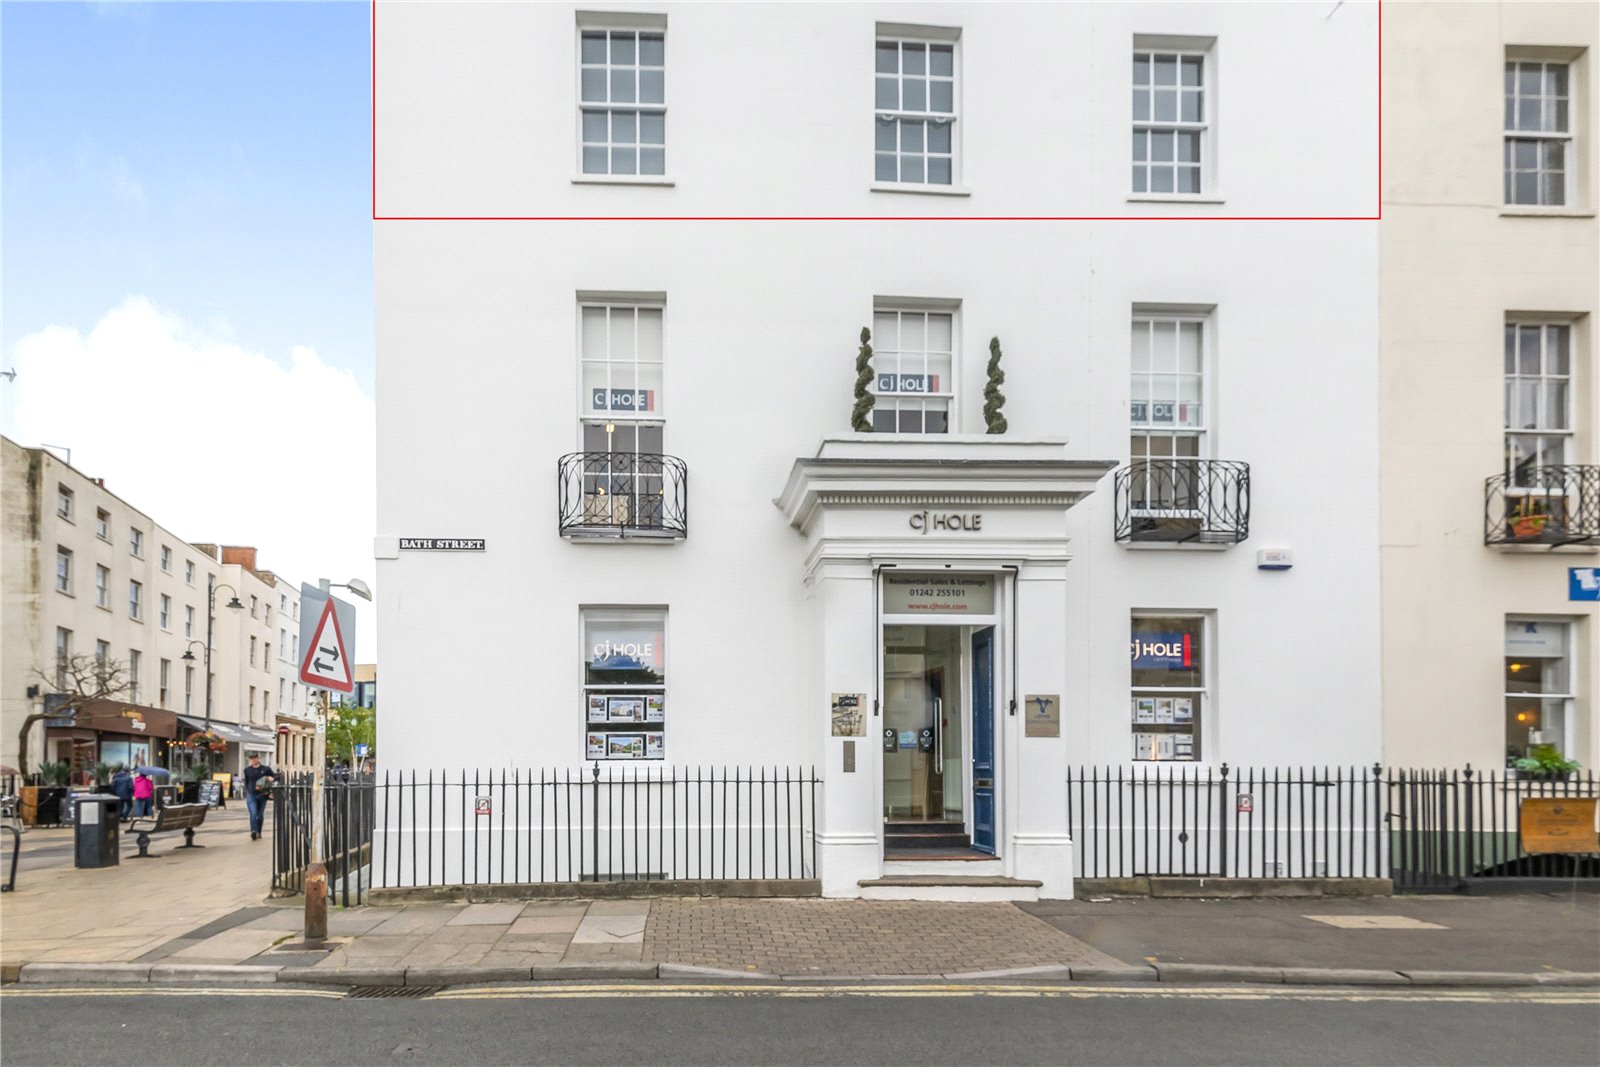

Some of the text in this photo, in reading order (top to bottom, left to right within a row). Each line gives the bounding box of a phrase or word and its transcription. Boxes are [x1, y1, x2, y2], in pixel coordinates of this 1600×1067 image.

[933, 513, 982, 531] HOLE
[401, 539, 432, 548] BATH
[889, 577, 986, 588] Residential Sales & Lettings
[909, 588, 966, 597] 01242 255101
[907, 602, 968, 611] www.cjhole.com
[613, 643, 653, 657] HOLE
[1142, 643, 1182, 657] HOLE
